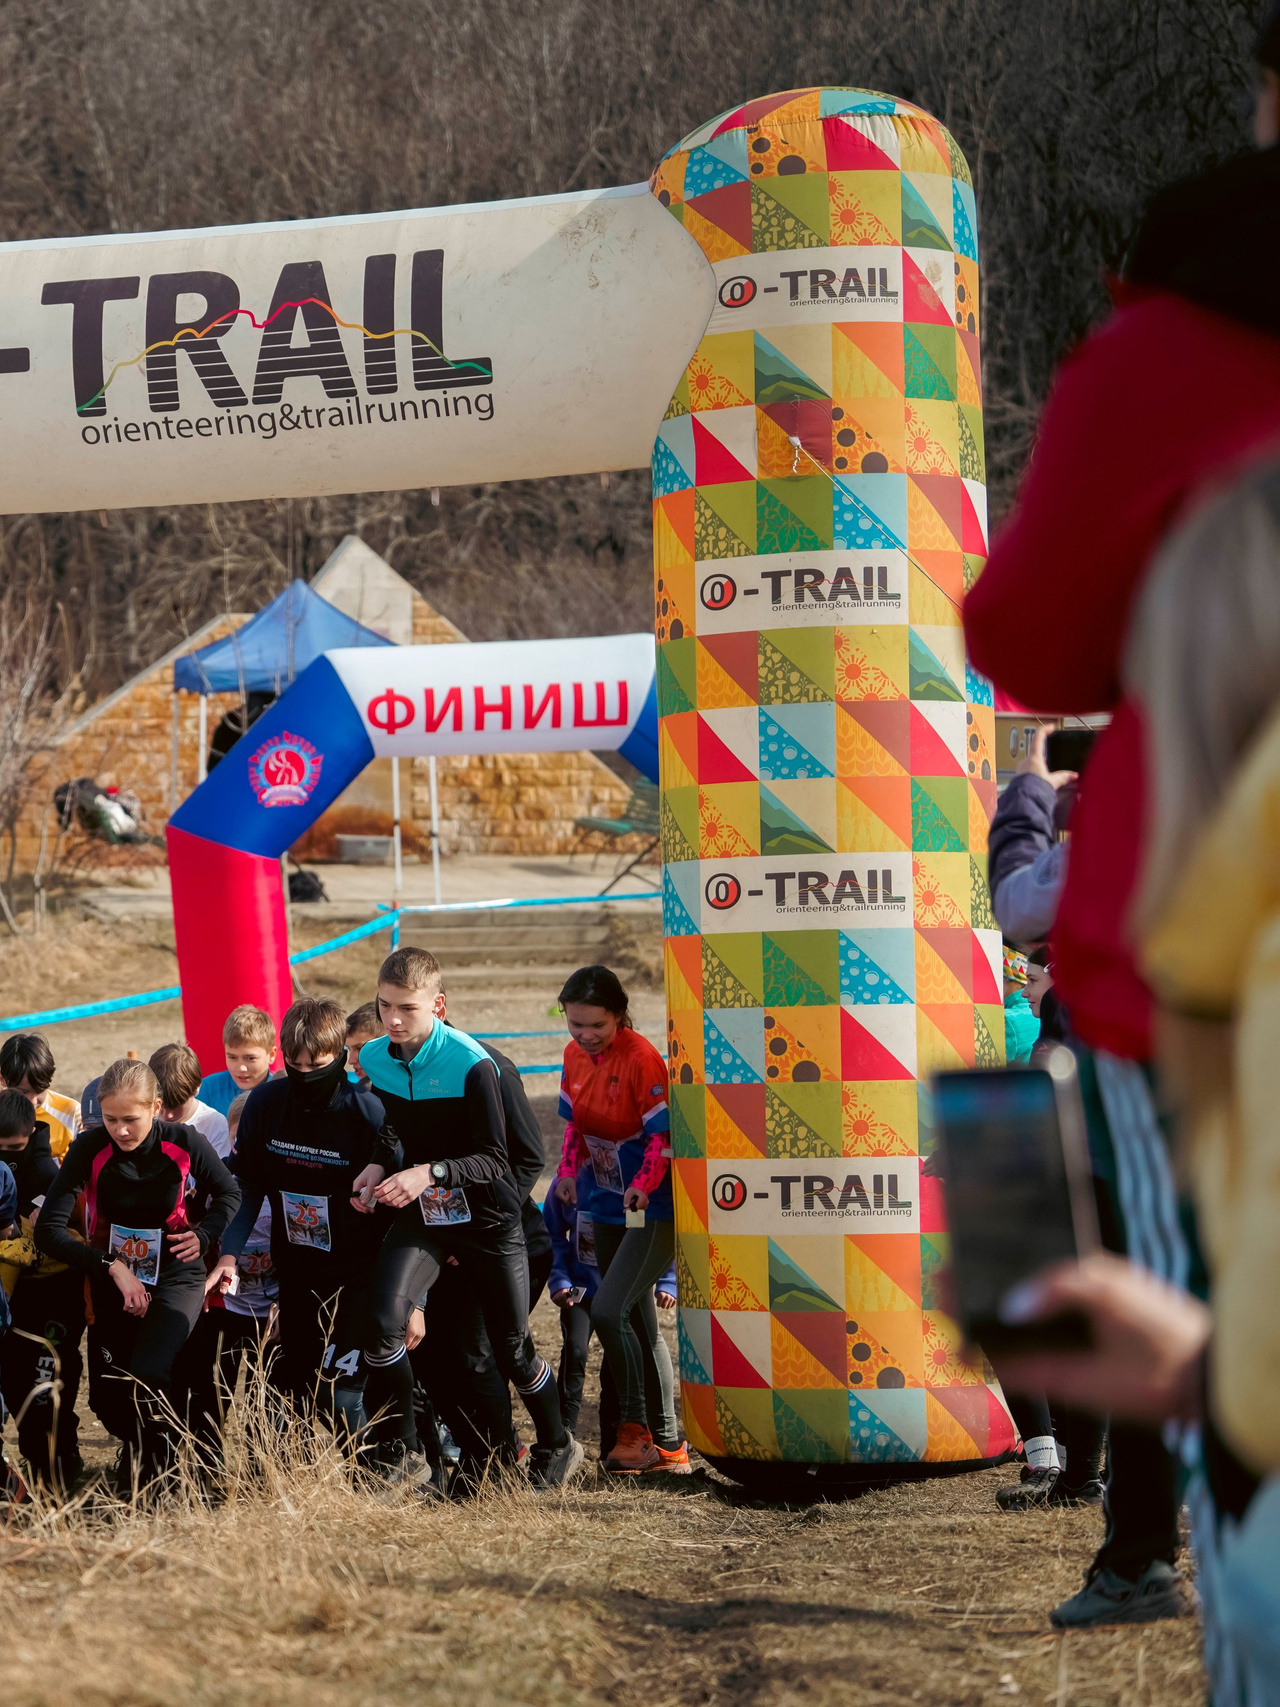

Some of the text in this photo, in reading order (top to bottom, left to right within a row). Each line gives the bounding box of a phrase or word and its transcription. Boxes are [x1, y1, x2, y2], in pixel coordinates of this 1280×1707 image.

[789, 296, 899, 307] orienteering&trailrunning
[81, 390, 495, 446] orienteering&trailrunning
[771, 599, 901, 612] orienteering&trailrunning
[366, 680, 629, 735] ФИНИШ
[775, 902, 906, 914] orienteering&trailrunning
[271, 1138, 295, 1151] СОЗДАЕМ
[295, 1144, 319, 1155] БУДУЩЕЕ
[310, 1155, 350, 1167] ВОЗМОЖНОСТИ
[294, 1204, 319, 1227] 25
[781, 1208, 912, 1218] orienteering&trailrunning
[120, 1239, 149, 1259] 40
[246, 1252, 271, 1275] 26
[323, 1343, 361, 1377] 14
